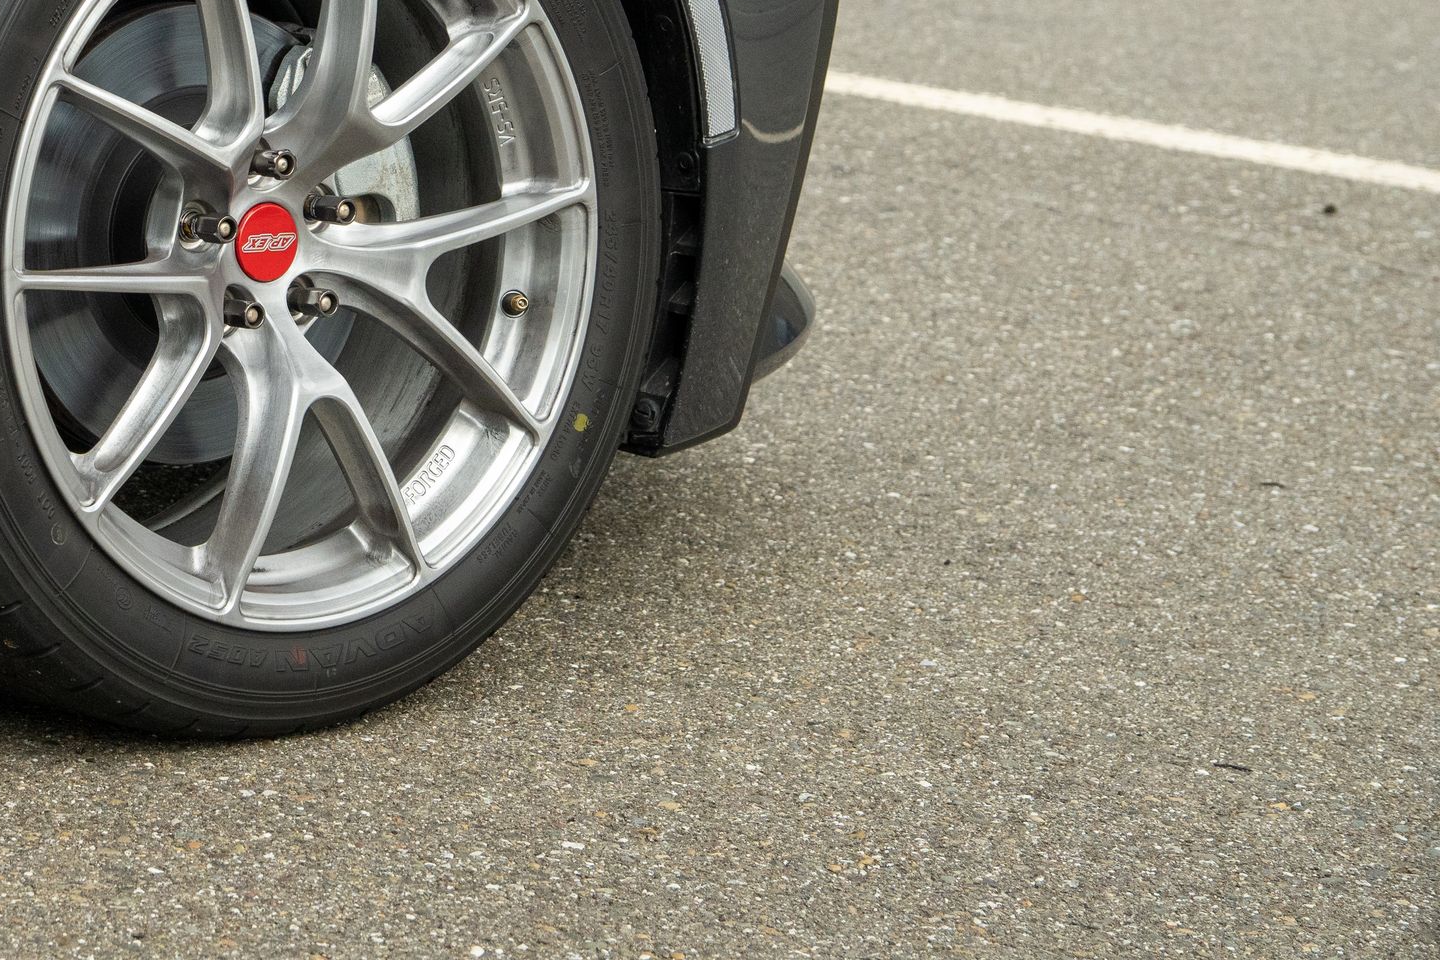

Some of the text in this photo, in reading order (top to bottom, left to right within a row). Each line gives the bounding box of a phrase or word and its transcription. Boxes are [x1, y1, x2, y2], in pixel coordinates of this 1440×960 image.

[242, 232, 296, 253] APEX
[404, 444, 456, 505] FORGED
[185, 603, 439, 672] ADVAN A052
